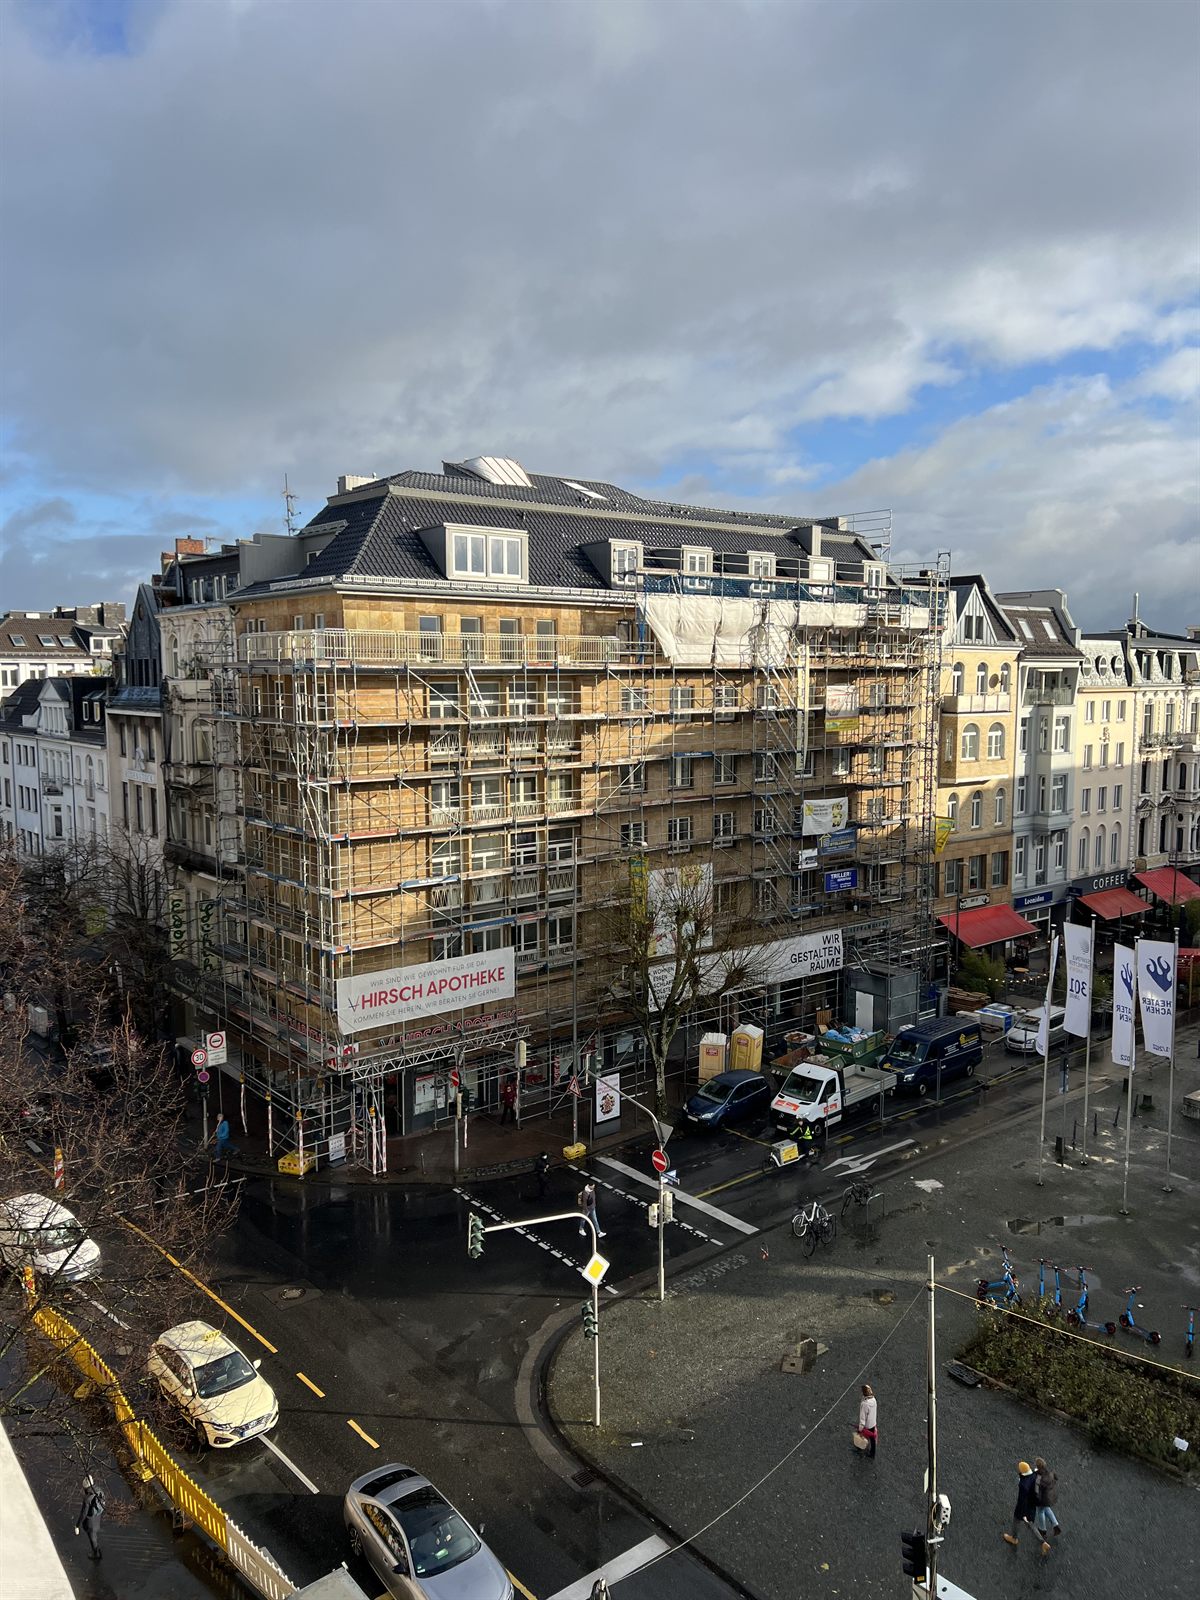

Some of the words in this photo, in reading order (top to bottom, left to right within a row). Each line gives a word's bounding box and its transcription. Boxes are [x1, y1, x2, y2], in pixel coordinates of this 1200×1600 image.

[1093, 873, 1125, 890] COFFEE
[822, 933, 840, 945] WIR
[790, 945, 841, 964] GESTALTEN
[403, 973, 416, 981] WIE
[466, 961, 475, 969] SIE
[361, 983, 423, 1010] HIRSCH
[426, 966, 506, 997] APOTHEKE
[354, 1012, 385, 1024] KOMMEN
[386, 1009, 396, 1017] SIE
[425, 1000, 437, 1009] WIR
[438, 995, 467, 1006] BERATEN
[468, 992, 476, 1000] SIE
[195, 1054, 204, 1062] 30
